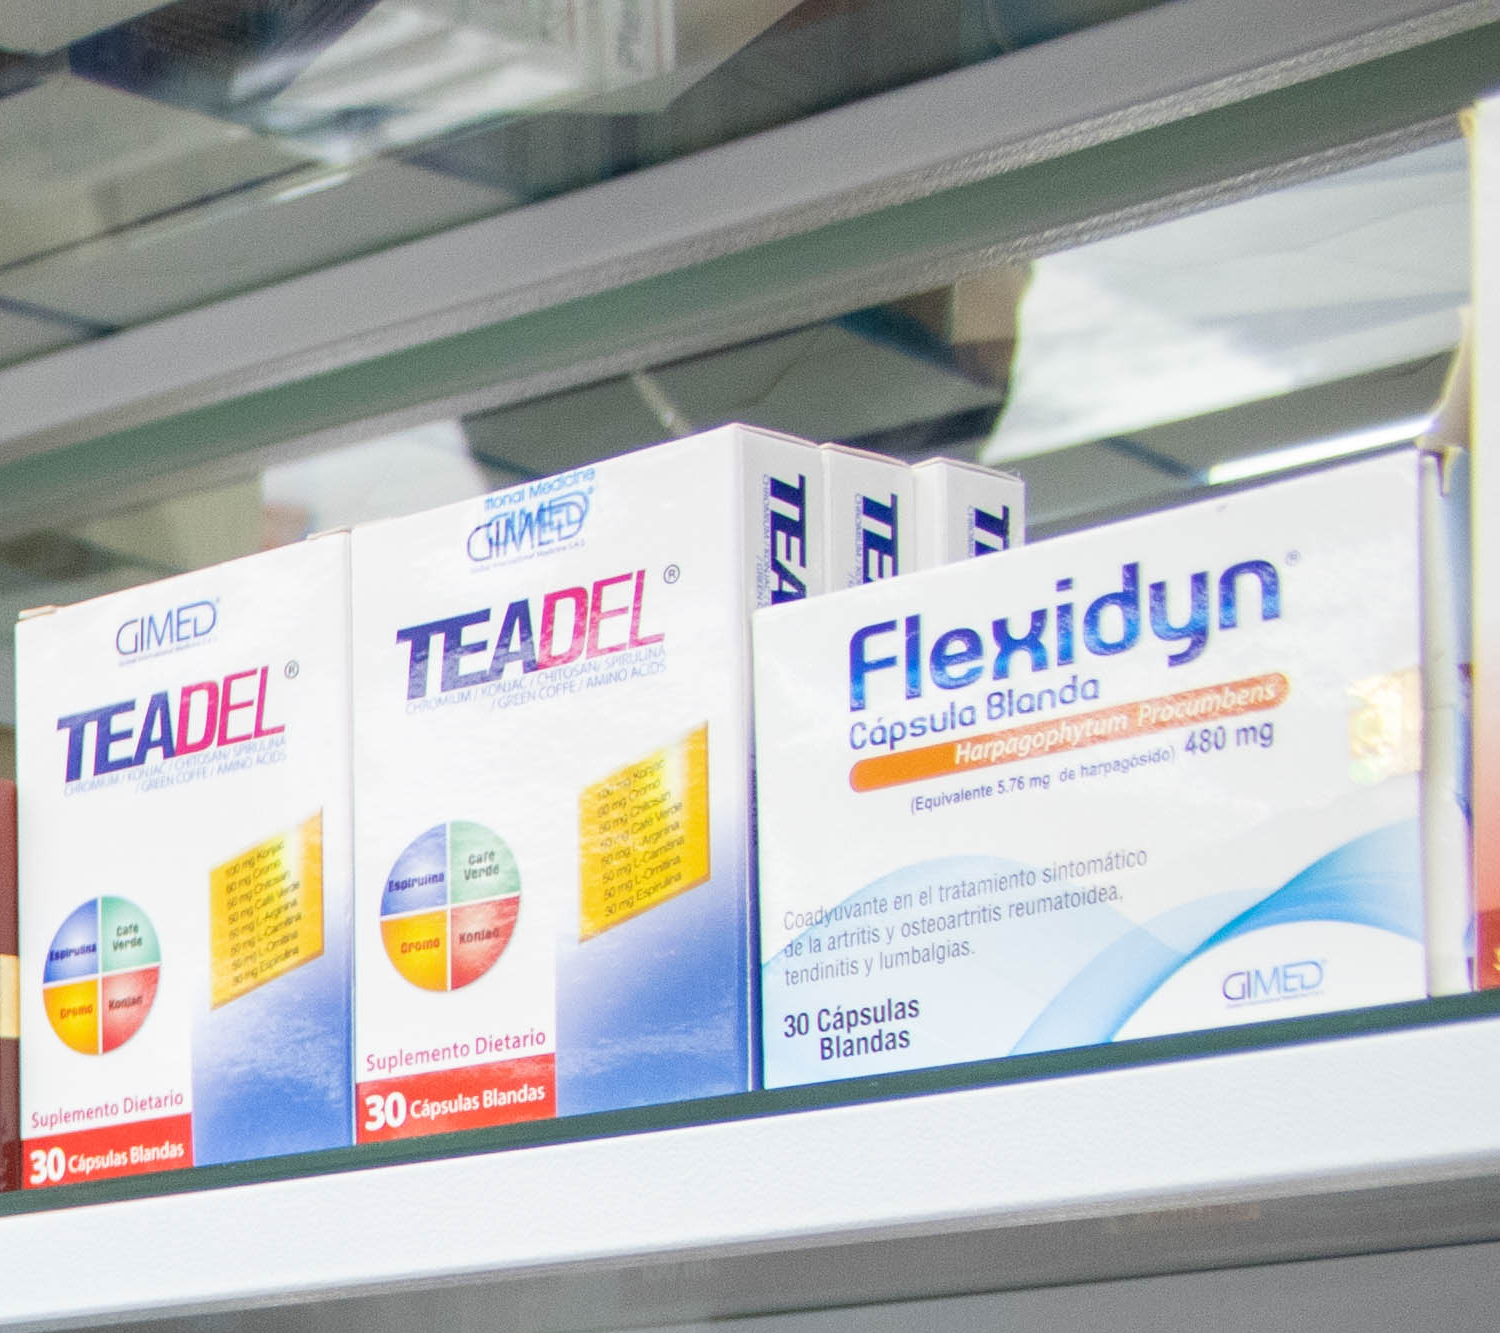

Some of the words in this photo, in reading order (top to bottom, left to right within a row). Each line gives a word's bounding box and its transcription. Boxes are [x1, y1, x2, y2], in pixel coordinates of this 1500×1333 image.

[115, 601, 219, 658] GIMED
[396, 569, 665, 701] TEADEL
[849, 558, 1282, 712] Flexidyn
[56, 664, 287, 785] TEADEL
[850, 708, 976, 754] Cápsula
[986, 678, 1100, 722] Blanda
[954, 711, 1129, 766] Harpagophytum
[1137, 678, 1278, 728] Procumbens
[996, 775, 1026, 795] 5.76
[1029, 773, 1051, 791] mg
[1058, 765, 1076, 782] de
[1185, 726, 1229, 756] 480
[1236, 722, 1274, 754] mg
[783, 895, 888, 934] Coadyuvante
[893, 892, 914, 911] en
[919, 884, 932, 908] el
[938, 871, 1037, 904] tratamiento
[1042, 846, 1148, 888] sintomático
[783, 938, 803, 959] de
[808, 935, 823, 956] la
[828, 926, 881, 953] artritis
[885, 925, 896, 946] y
[901, 905, 1002, 942] osteoartritis
[1007, 882, 1124, 920] reumatoidea.
[784, 955, 859, 986] tendinitis
[864, 958, 874, 978] y
[879, 939, 976, 974] lumbalgias.
[1222, 960, 1325, 1004] GIMED
[366, 1037, 471, 1075] Suplemento
[475, 1027, 546, 1054] Dietario
[784, 1014, 810, 1039] 30
[817, 997, 921, 1036] Cápsulas
[819, 1028, 911, 1062] Blandas
[364, 1091, 408, 1130] 30
[409, 1092, 479, 1122] Cápsulas
[482, 1081, 546, 1109] Blandas
